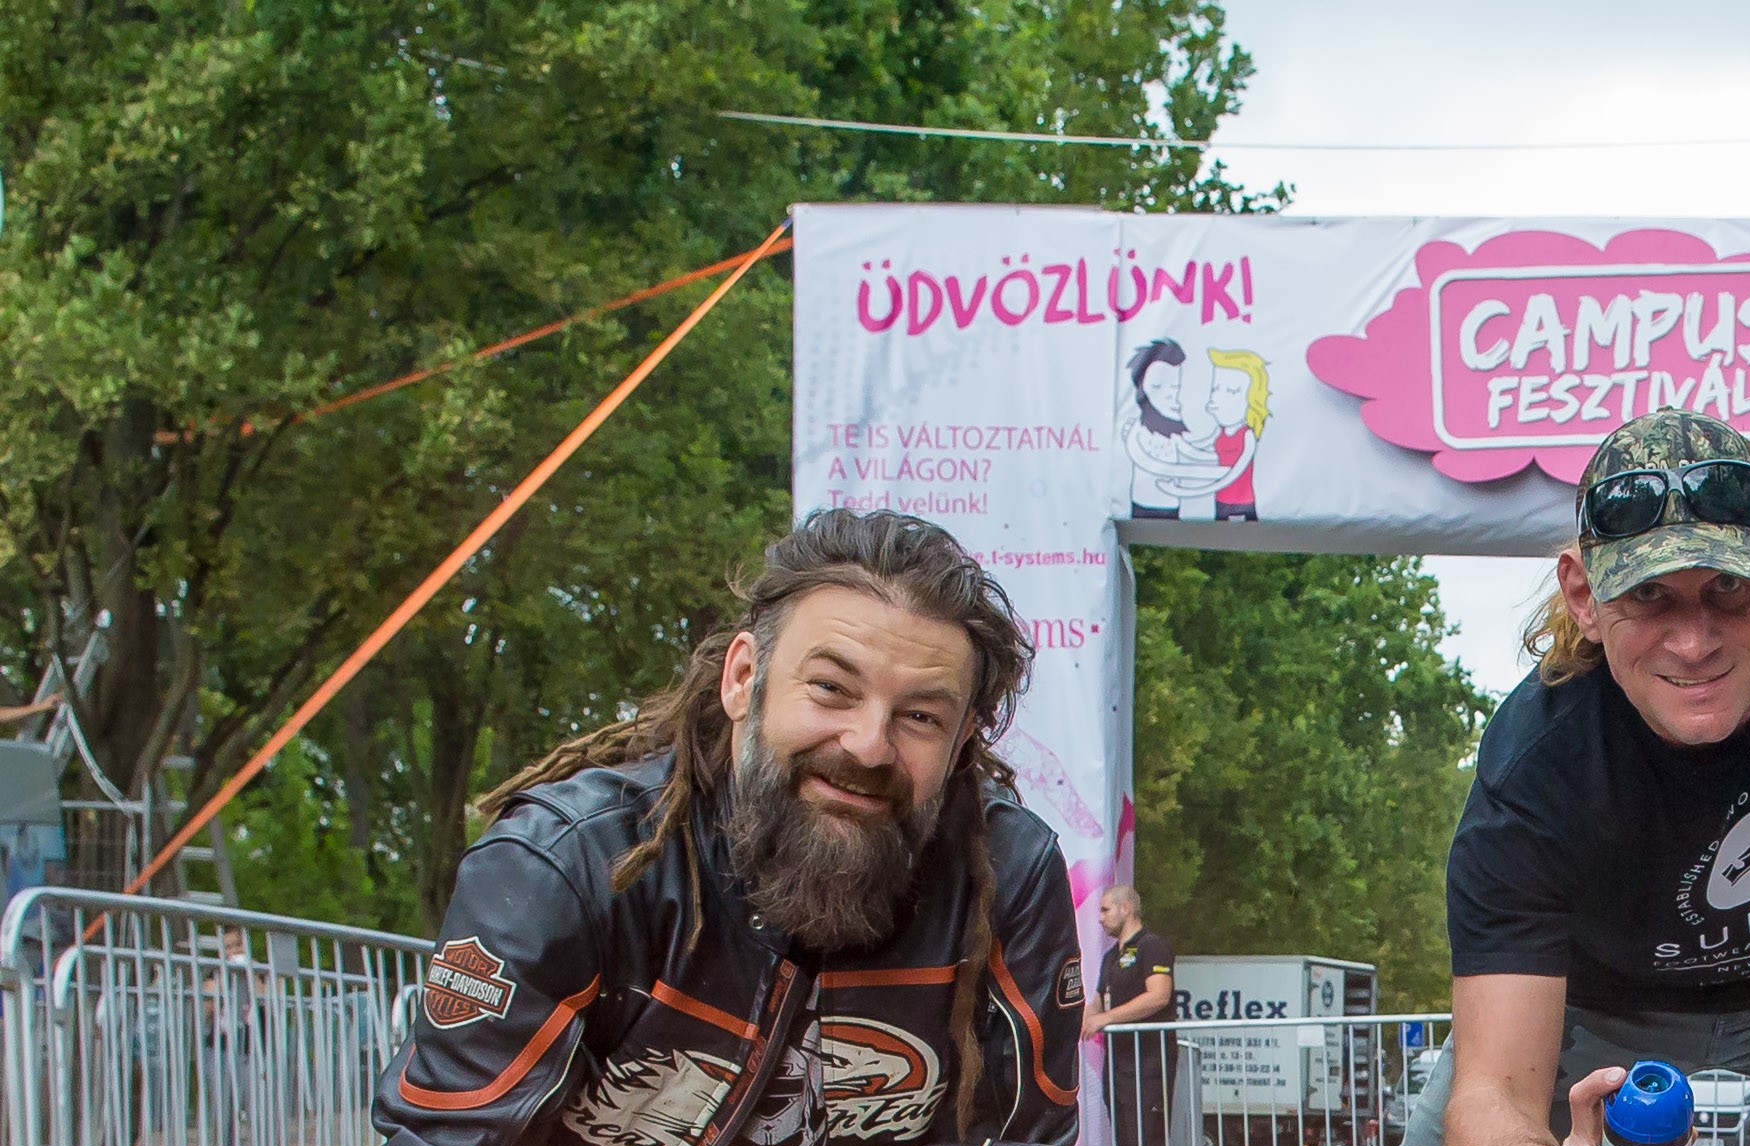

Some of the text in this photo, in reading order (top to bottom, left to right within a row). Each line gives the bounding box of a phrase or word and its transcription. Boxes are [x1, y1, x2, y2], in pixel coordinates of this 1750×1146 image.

[857, 249, 1253, 336] ÜDVÖZLÜNK!
[828, 420, 1100, 452] TE IS VÁLTOZTATNÁL
[828, 455, 992, 483] A VILÁGON?
[897, 490, 988, 515] velünk!
[1676, 840, 1720, 926] ESTABLISHED
[446, 948, 488, 973] MOTOR
[428, 964, 503, 1006] HARLEY-DAVIDSON
[426, 989, 471, 1018] CYCLES
[1174, 990, 1287, 1020] Reflex
